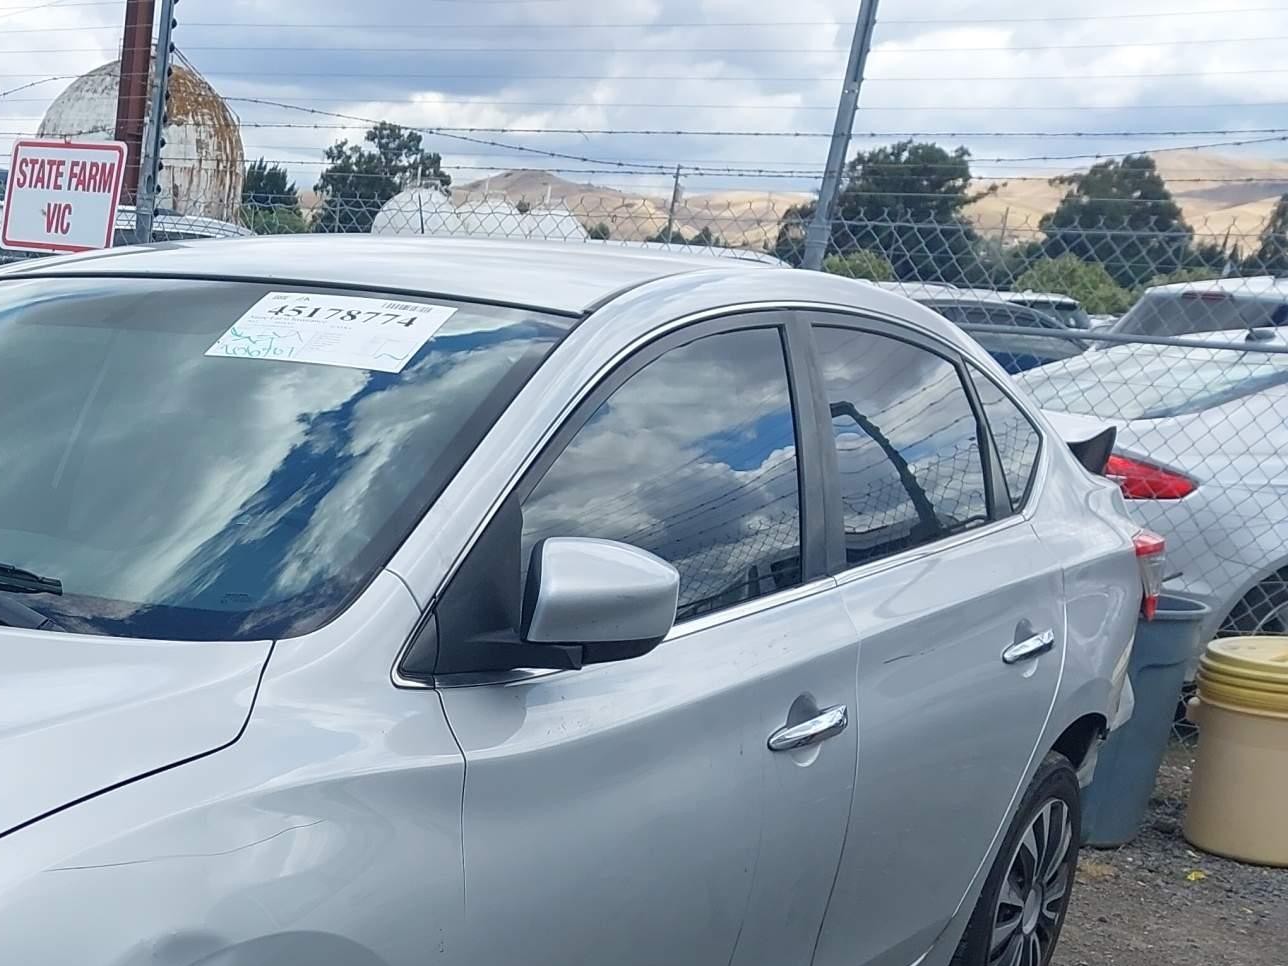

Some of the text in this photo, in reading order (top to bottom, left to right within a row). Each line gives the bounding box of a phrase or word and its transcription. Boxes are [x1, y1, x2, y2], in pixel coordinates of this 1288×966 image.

[16, 157, 116, 194] STATE FARM
[45, 202, 73, 235] VIC
[267, 304, 418, 328] 45178774
